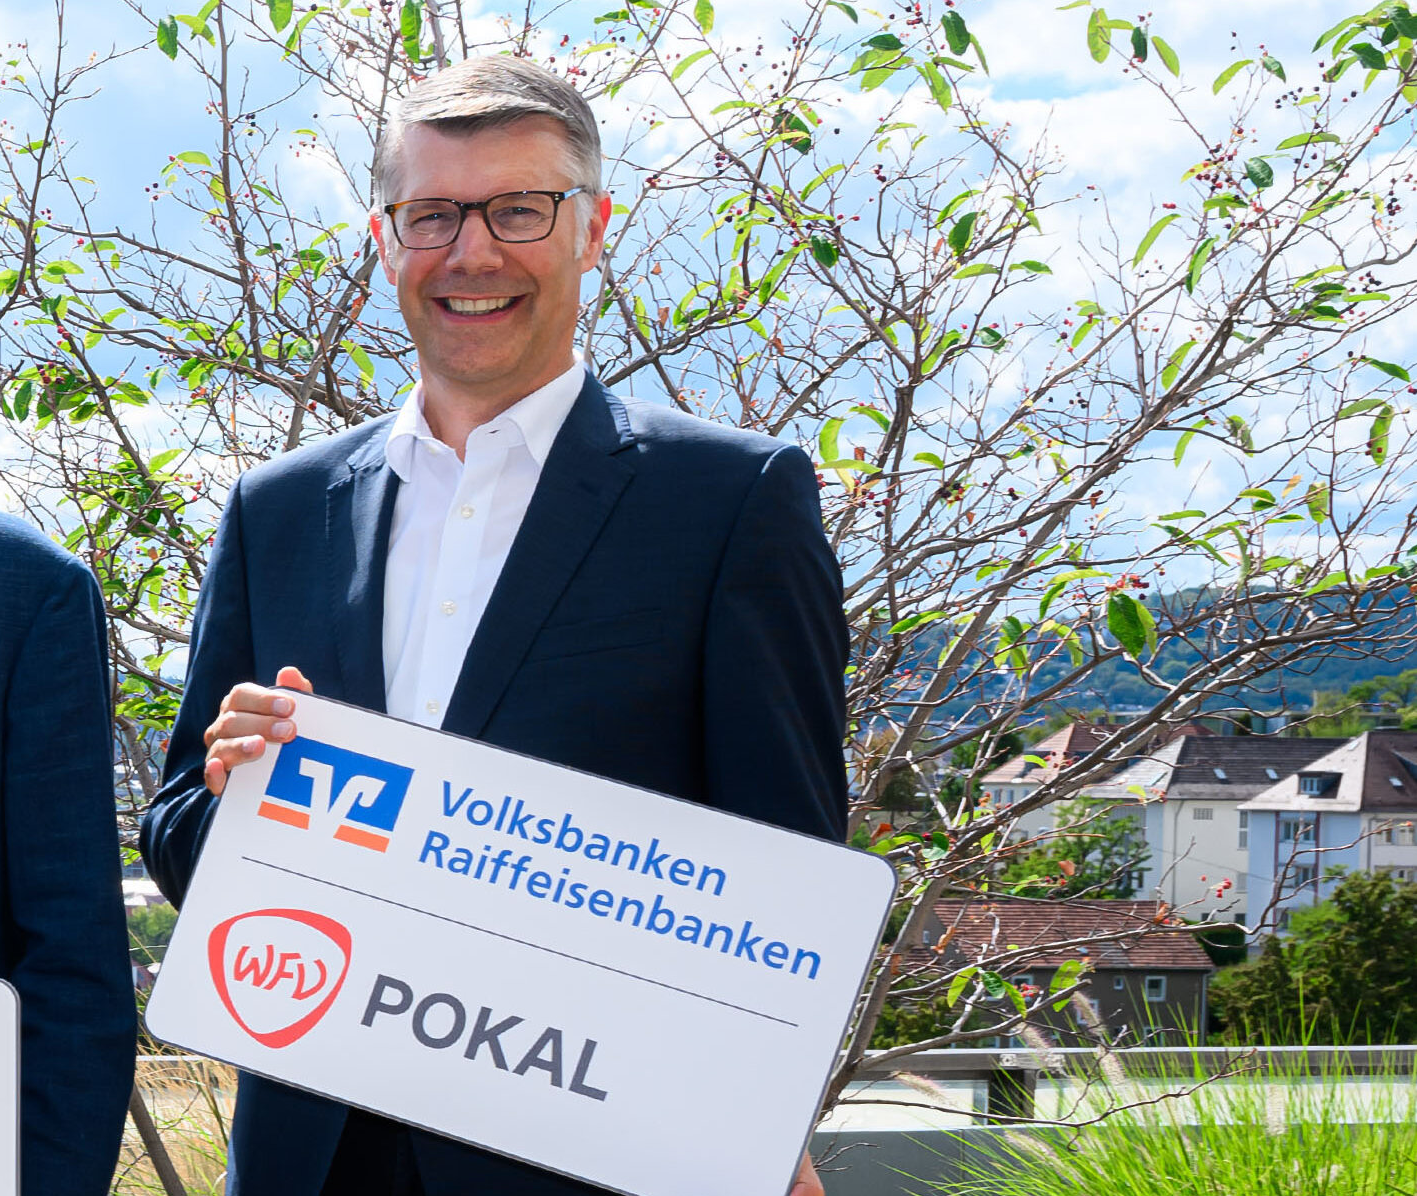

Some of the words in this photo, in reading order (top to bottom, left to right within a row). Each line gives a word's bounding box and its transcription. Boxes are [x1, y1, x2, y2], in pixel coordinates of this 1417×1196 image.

[417, 829, 823, 981] Raiffeisenbanken
[442, 779, 728, 898] Volksbanken
[233, 943, 328, 1001] WFV
[360, 974, 609, 1102] POKAL
